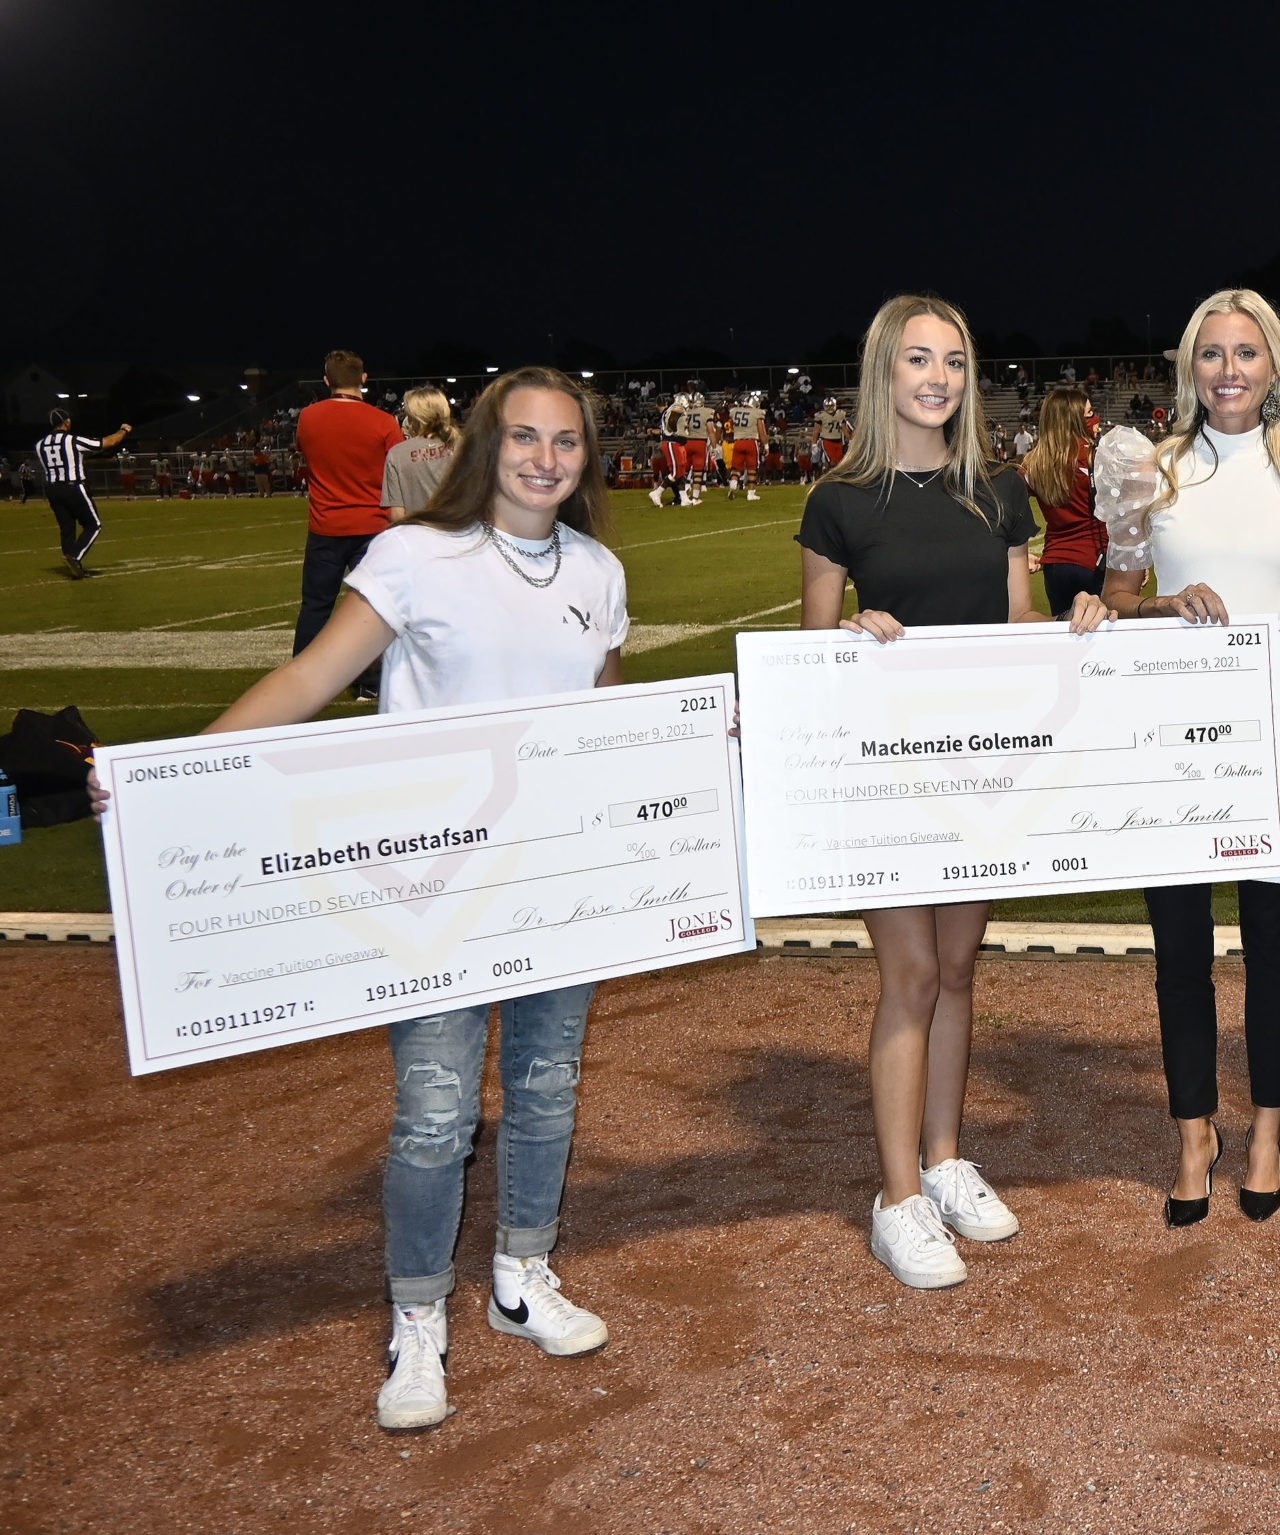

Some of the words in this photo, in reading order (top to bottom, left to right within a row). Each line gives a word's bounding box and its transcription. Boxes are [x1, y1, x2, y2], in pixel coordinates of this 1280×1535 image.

[734, 411, 750, 427] 55
[44, 445, 64, 467] H
[1228, 633, 1261, 646] 2021
[803, 651, 858, 665] COLEGE
[1080, 662, 1116, 677] Date
[1132, 658, 1198, 675] September
[1214, 656, 1240, 668] 2021
[681, 696, 717, 712] 2021
[518, 742, 559, 761] Date
[577, 730, 651, 754] September
[666, 722, 696, 739] 2021
[816, 728, 827, 739] to
[831, 725, 850, 738] the
[783, 751, 827, 770] Order
[830, 754, 844, 771] of
[862, 735, 962, 757] Mackenzie
[968, 733, 1052, 751] Goleman
[126, 765, 179, 783] JONES
[182, 755, 252, 775] COLLEGE
[785, 787, 827, 802] FOUR
[833, 783, 909, 799] HUNDRED
[914, 779, 978, 796] SEVENTY
[982, 777, 1013, 792] AND
[1214, 763, 1262, 778] Dollars
[1103, 807, 1164, 835] Jesse
[1169, 804, 1236, 827] Smith
[825, 835, 867, 848] Vaccine
[870, 832, 907, 845] Tuition
[909, 832, 962, 845] Giveaway
[1209, 834, 1272, 860] JONES
[204, 850, 219, 862] to
[223, 842, 248, 858] the
[1222, 849, 1256, 857] COLLEGE
[165, 879, 221, 900] Order
[223, 874, 243, 897] of
[261, 842, 370, 875] Elizabeth
[377, 826, 488, 856] Gustafsan
[1052, 858, 1088, 872] 0001
[168, 916, 223, 937] FOUR
[227, 898, 322, 930] HUNDRED
[327, 885, 406, 912] SEVENTY
[409, 880, 445, 899] AND
[669, 836, 720, 856] Dollars
[550, 896, 617, 930] Jesse
[622, 882, 694, 913] Smith
[666, 909, 732, 942] JONES
[680, 925, 716, 938] COLLEGE
[222, 968, 276, 987] Vaccine
[276, 959, 324, 977] Tuition
[325, 947, 387, 968] Giveaway
[493, 957, 533, 977] 0001
